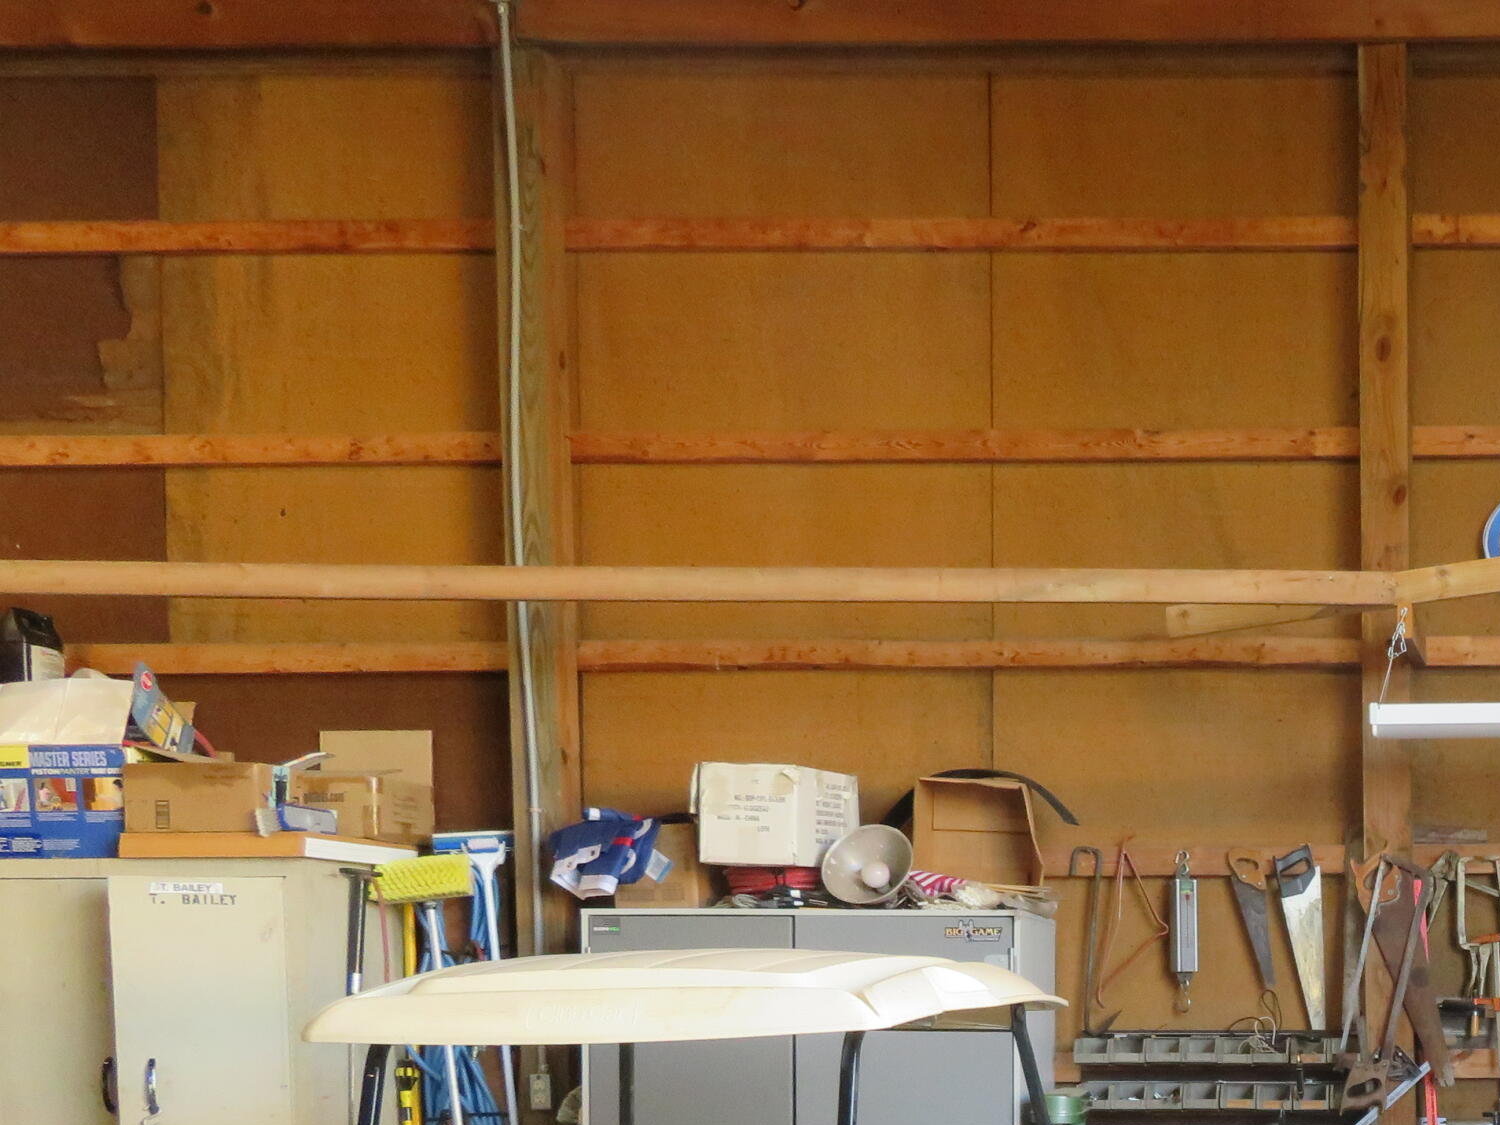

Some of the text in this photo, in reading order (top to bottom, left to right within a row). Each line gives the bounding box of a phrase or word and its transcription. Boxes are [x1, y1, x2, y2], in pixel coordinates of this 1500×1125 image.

[31, 750, 108, 768] MASTER SERIES
[173, 883, 213, 892] BAILEY
[182, 893, 237, 906] BAILEY
[946, 927, 1002, 936] BIG GAME
